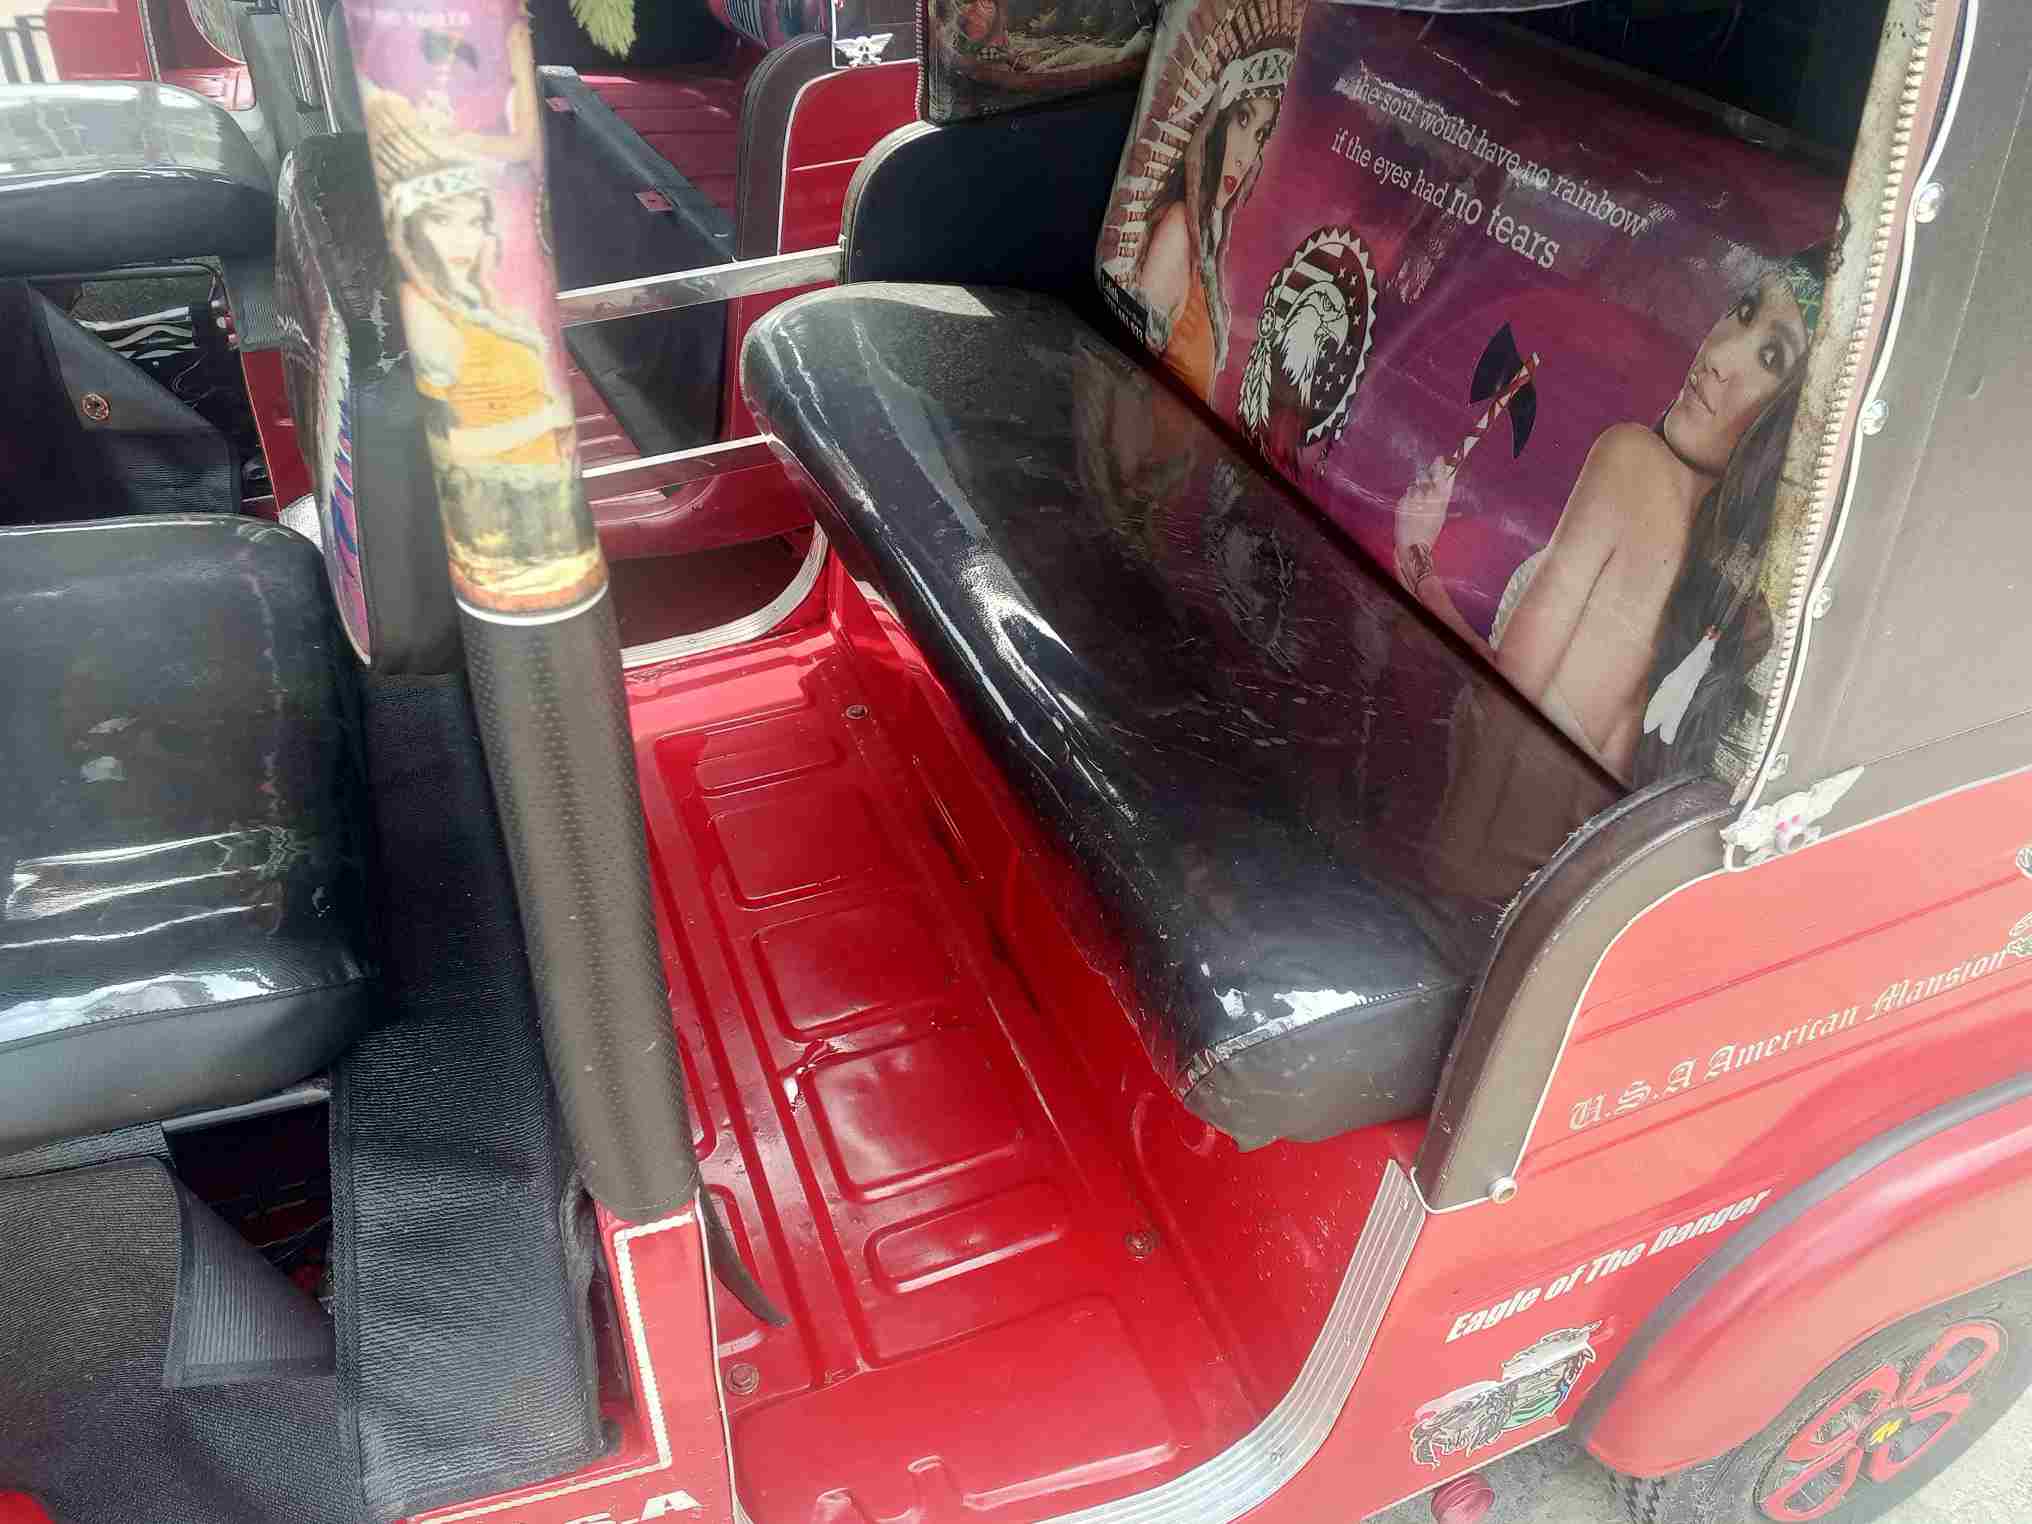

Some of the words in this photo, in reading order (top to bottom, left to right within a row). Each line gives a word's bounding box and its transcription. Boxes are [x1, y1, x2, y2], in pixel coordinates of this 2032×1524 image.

[1331, 128, 1350, 155] if
[1347, 136, 1373, 169] the
[1373, 156, 1412, 189] eyes
[1411, 168, 1449, 208] had
[1449, 186, 1482, 225] no
[1486, 203, 1560, 269] tears
[1351, 76, 1380, 105] the
[1380, 97, 1421, 124] soul
[1419, 110, 1474, 150] would
[1472, 128, 1521, 172] have
[1522, 158, 1550, 188] no
[1551, 174, 1648, 238] rainbow
[1704, 1004, 1859, 1080] American
[1865, 948, 2008, 1021] Mansion
[1444, 1286, 1543, 1344] Eagle
[1543, 1263, 1589, 1301] of
[1584, 1242, 1648, 1285] The
[1646, 1187, 1775, 1257] Danger
